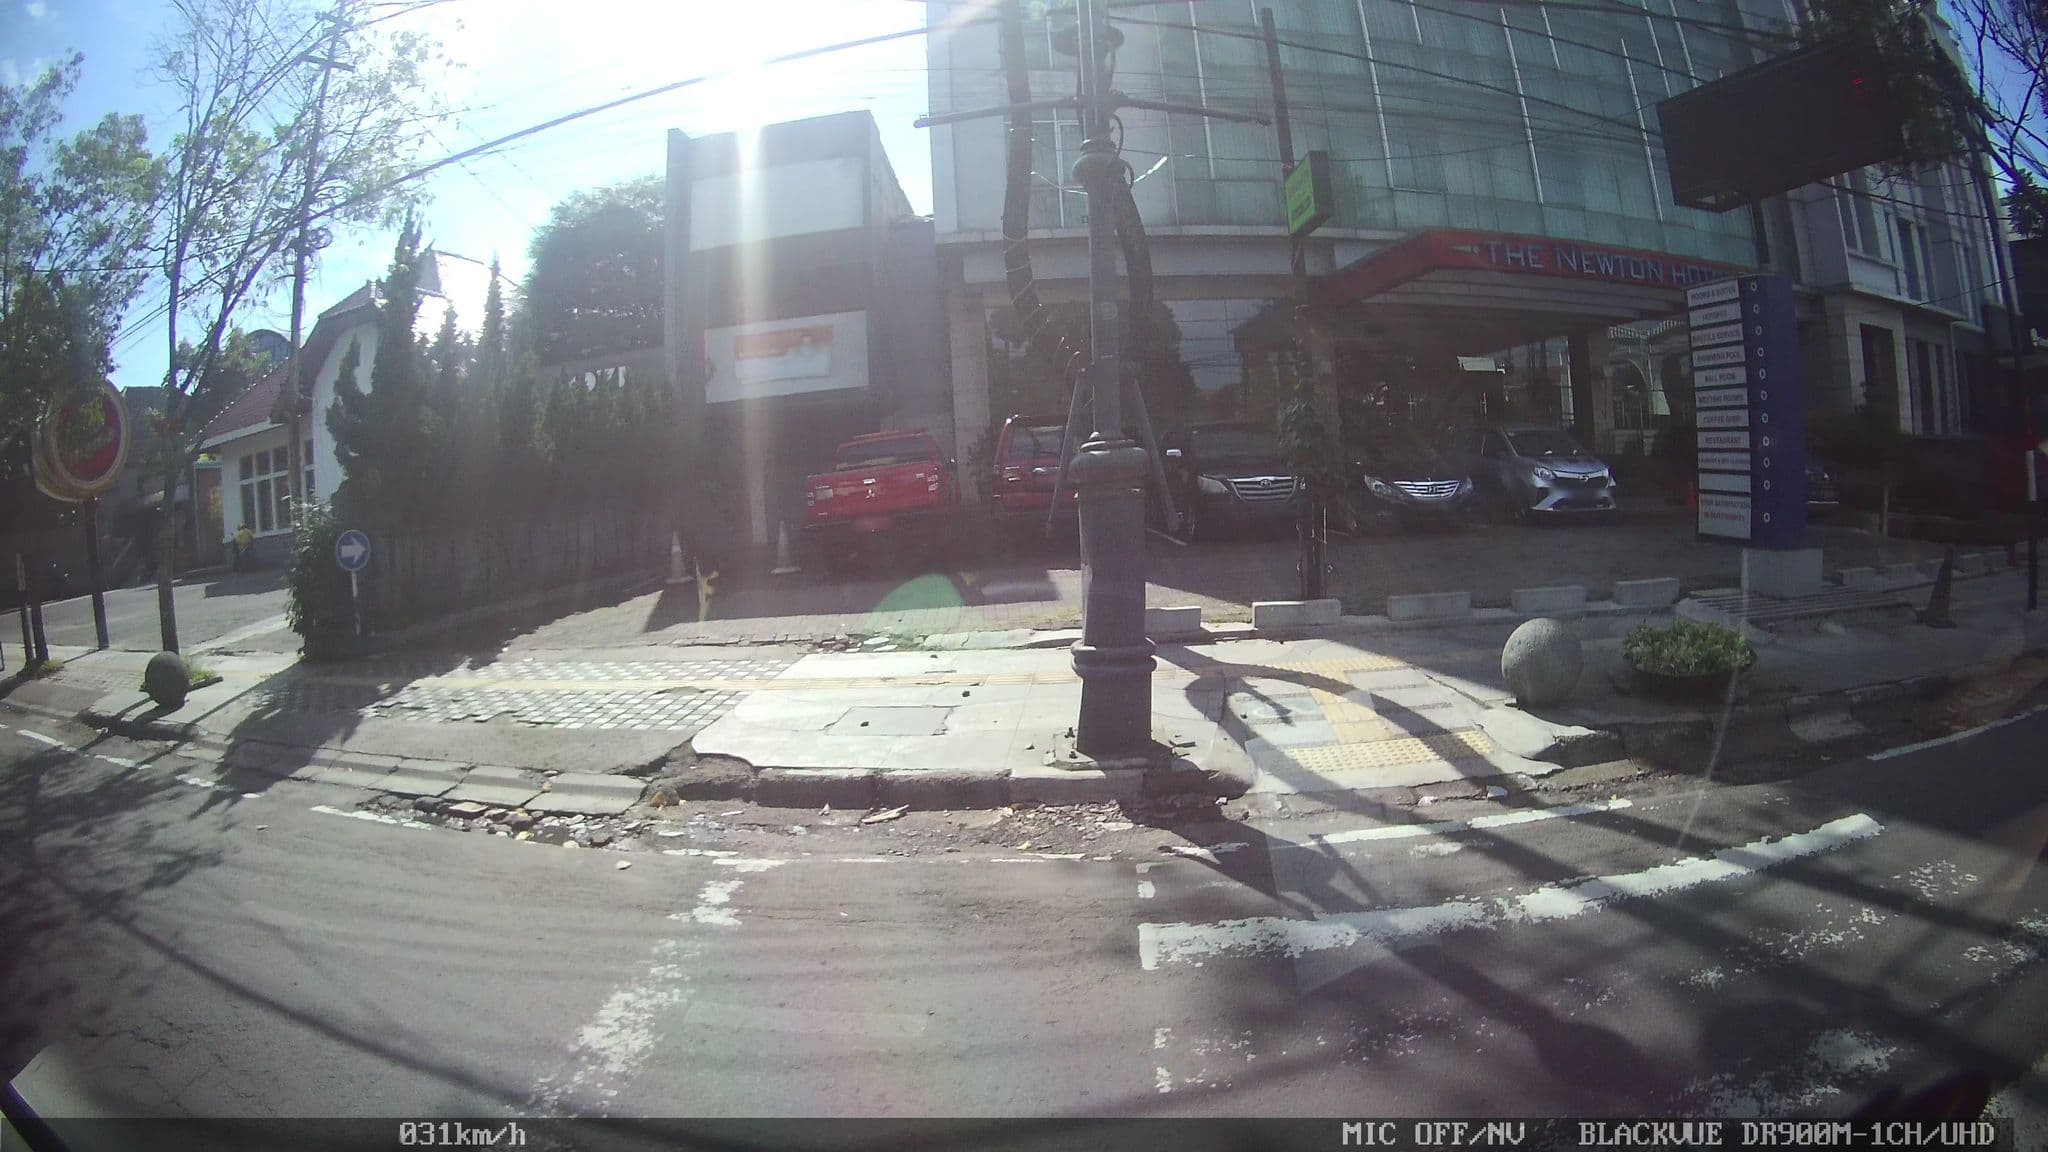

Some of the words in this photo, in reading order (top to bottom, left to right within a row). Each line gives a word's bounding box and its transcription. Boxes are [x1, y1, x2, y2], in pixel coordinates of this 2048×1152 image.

[1487, 240, 1544, 269] THE
[1555, 244, 1664, 282] NEWTON
[1705, 436, 1741, 445] RESTAURANT
